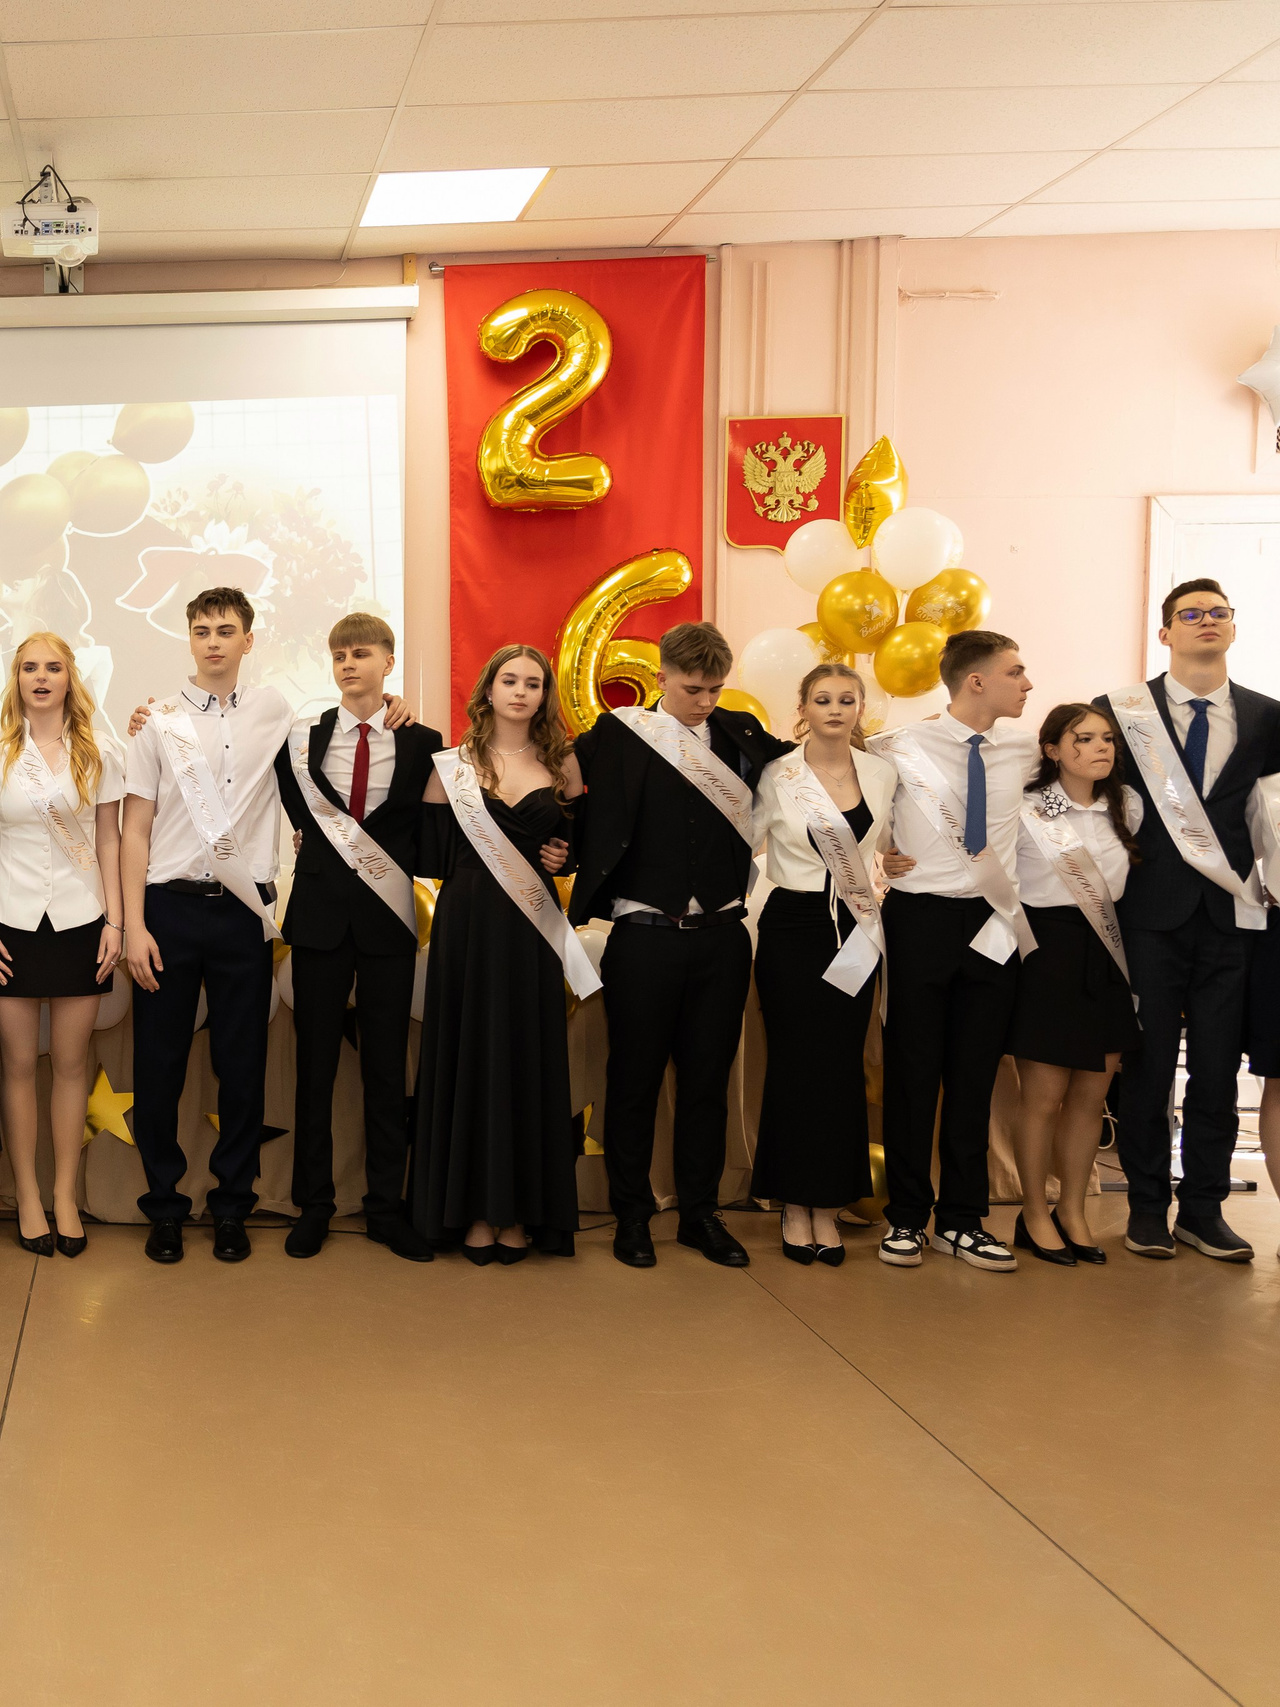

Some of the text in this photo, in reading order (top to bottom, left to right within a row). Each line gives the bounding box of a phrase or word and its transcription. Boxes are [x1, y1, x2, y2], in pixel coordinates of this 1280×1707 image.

[477, 288, 614, 512] 2
[553, 548, 694, 738] 6
[355, 851, 395, 881] 2026
[455, 788, 549, 913] Выпускница 2026
[794, 785, 878, 919] Выпускница 2026
[1105, 919, 1121, 949] 2026
